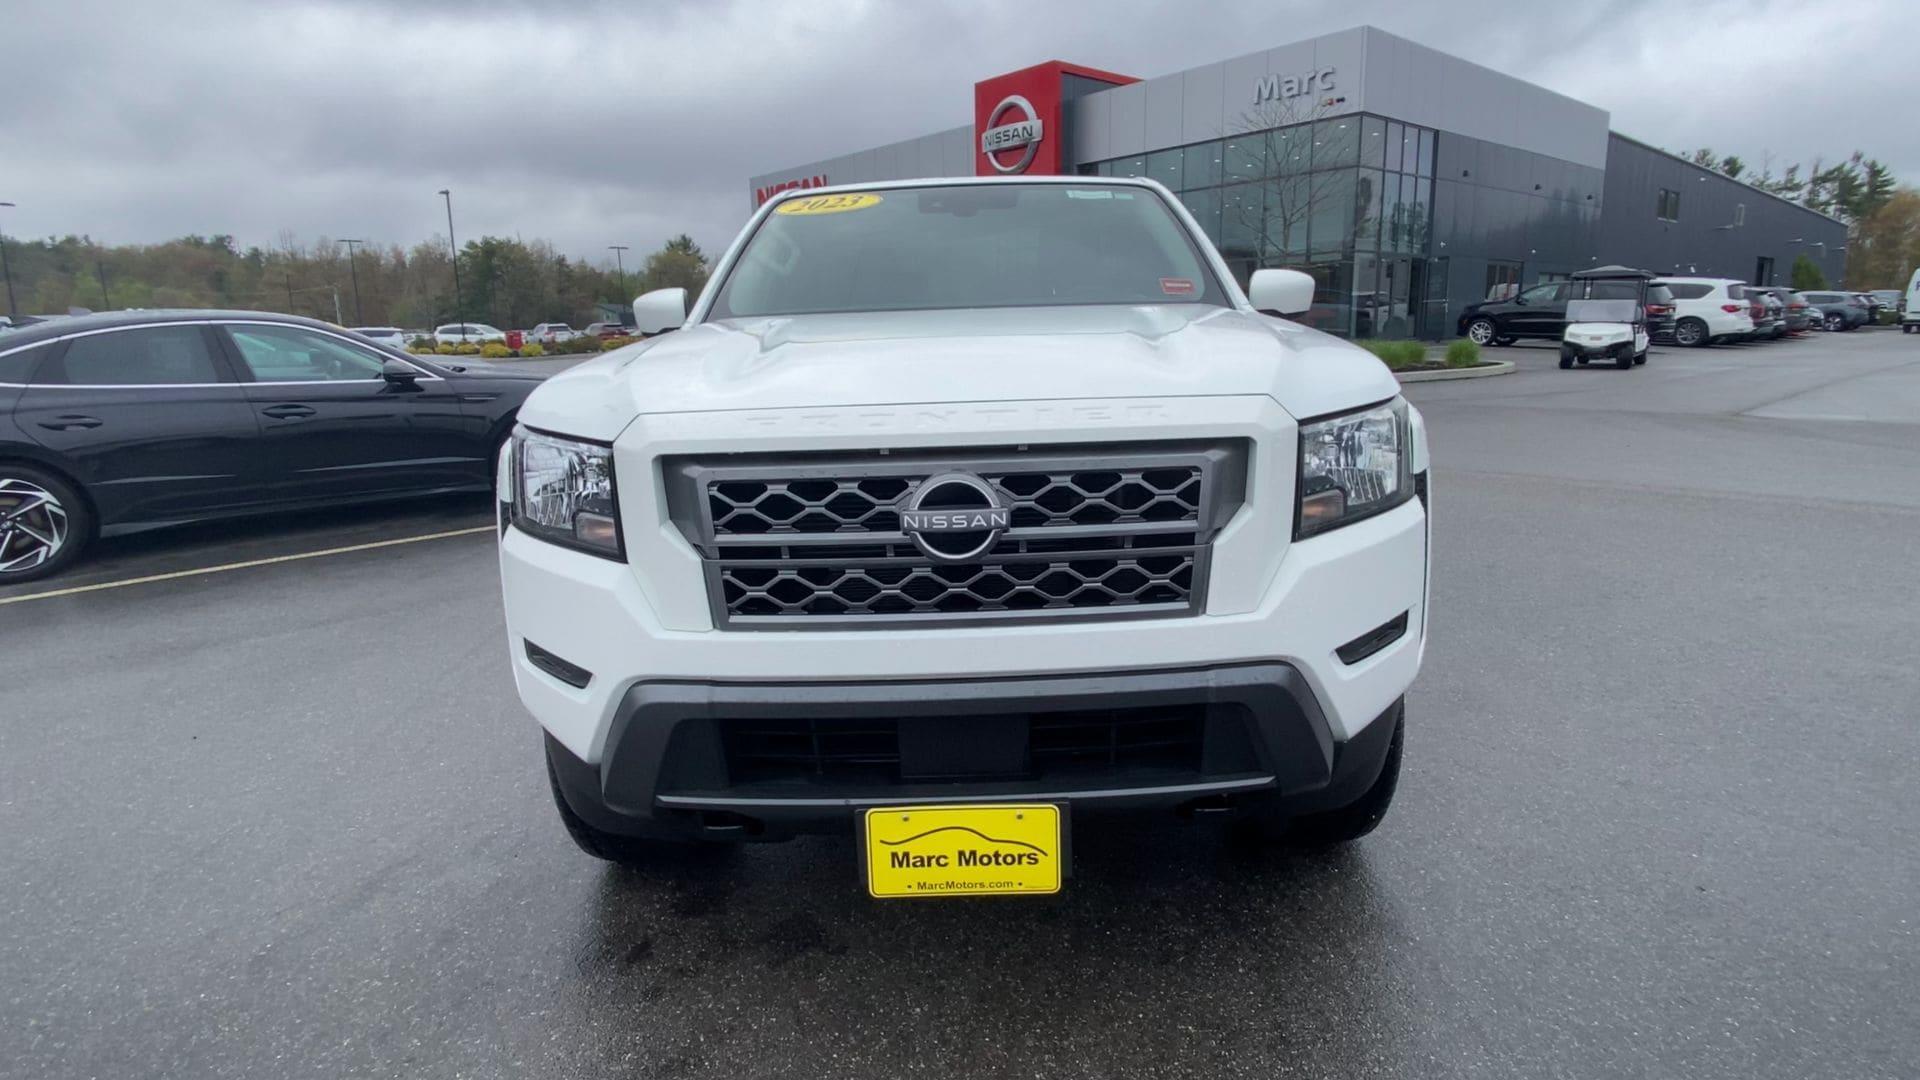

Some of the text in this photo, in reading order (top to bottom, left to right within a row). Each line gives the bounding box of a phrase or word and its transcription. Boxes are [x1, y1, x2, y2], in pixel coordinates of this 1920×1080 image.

[1253, 64, 1336, 105] Marc
[985, 125, 1033, 147] NISSAN
[788, 195, 864, 212] 2023
[745, 405, 1171, 428] FRONTIER
[903, 512, 1007, 529] NISSAN
[891, 849, 1039, 868] Marc Motors
[917, 880, 1014, 891] MarcMotors.com
